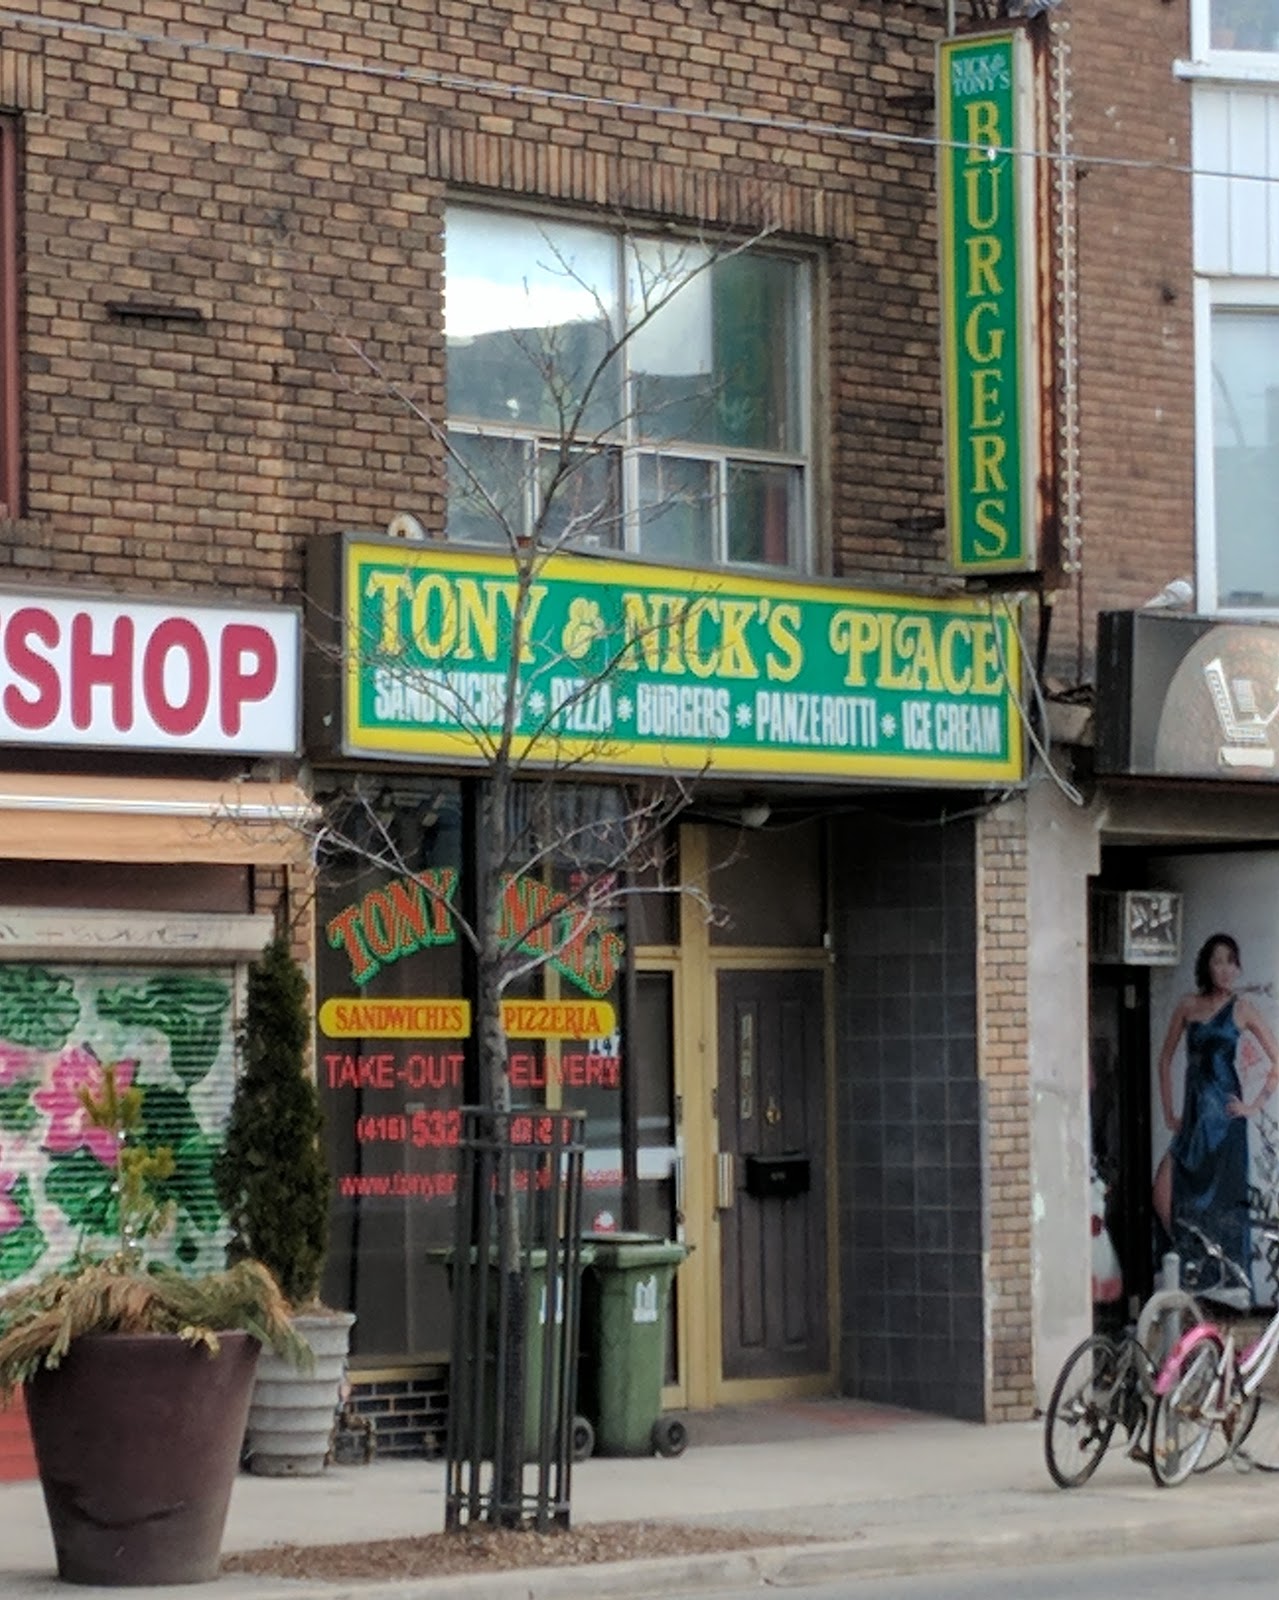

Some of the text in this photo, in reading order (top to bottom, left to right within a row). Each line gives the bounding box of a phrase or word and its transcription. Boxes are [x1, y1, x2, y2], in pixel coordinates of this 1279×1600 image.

[963, 101, 1009, 557] BURGERS
[3, 607, 278, 738] SHOP
[365, 569, 1004, 696] TONY & NICK'S PLACE
[550, 677, 613, 733] PIZZA
[636, 682, 730, 740] BURGERS
[756, 690, 877, 748] PANZEROTTI
[902, 699, 933, 751] ICE
[935, 702, 1001, 754] CREAM
[327, 868, 457, 986] TONY
[324, 1054, 465, 1089] TAKE-OUT
[335, 1004, 601, 1038] SANDWICHES PIZZERIA
